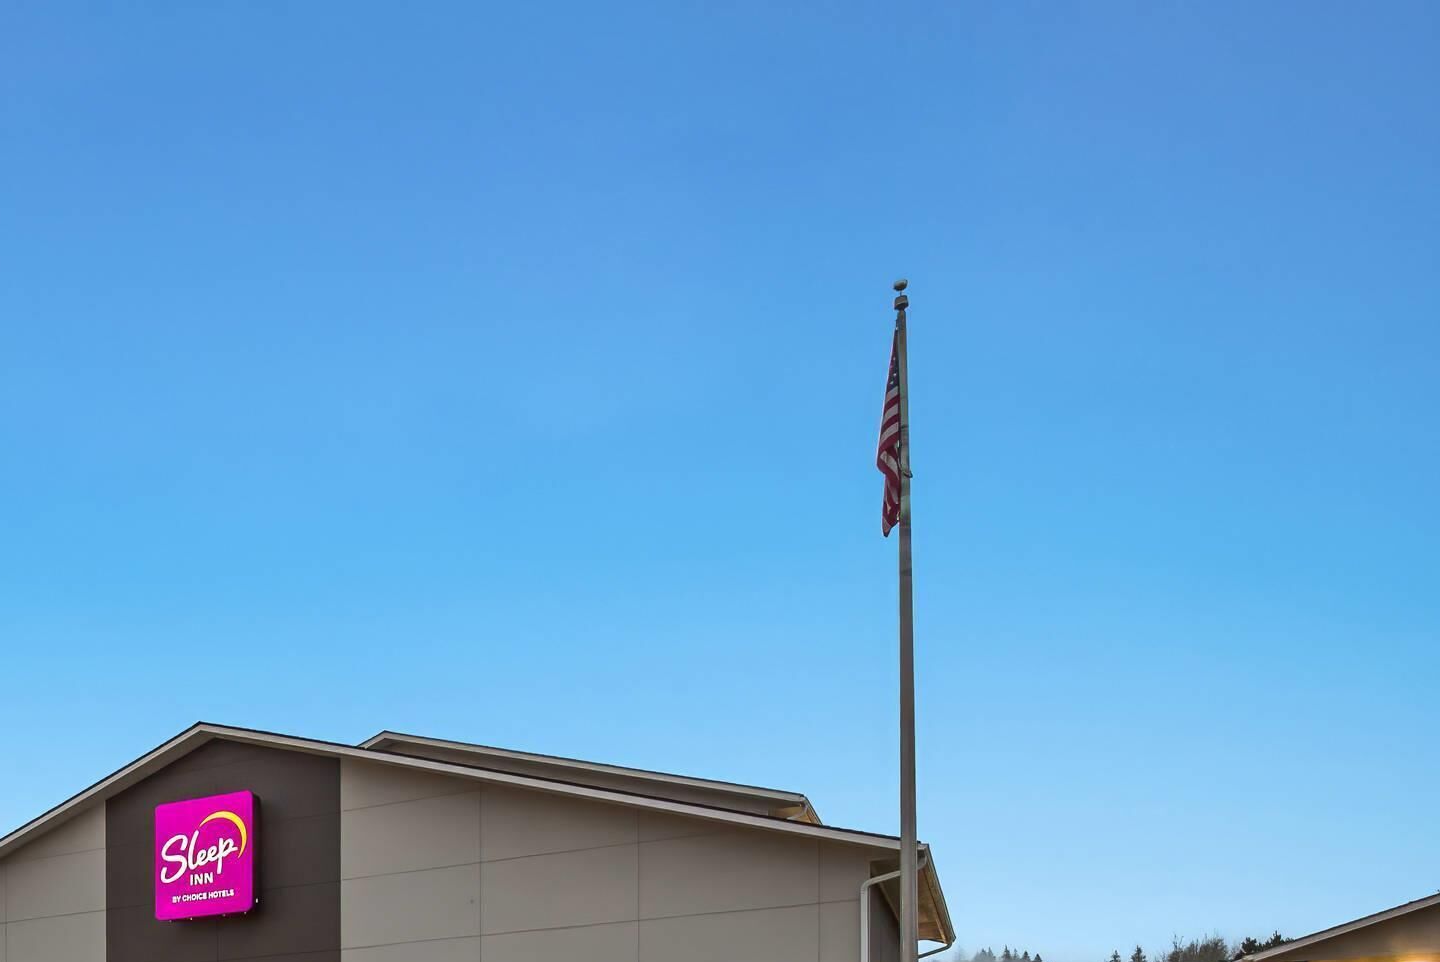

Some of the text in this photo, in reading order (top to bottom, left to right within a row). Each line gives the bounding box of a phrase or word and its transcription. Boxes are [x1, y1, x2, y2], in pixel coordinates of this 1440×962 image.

[160, 830, 238, 884] Sleep
[190, 872, 214, 886] INN
[172, 888, 234, 904] BY CHOICE HOTELS
